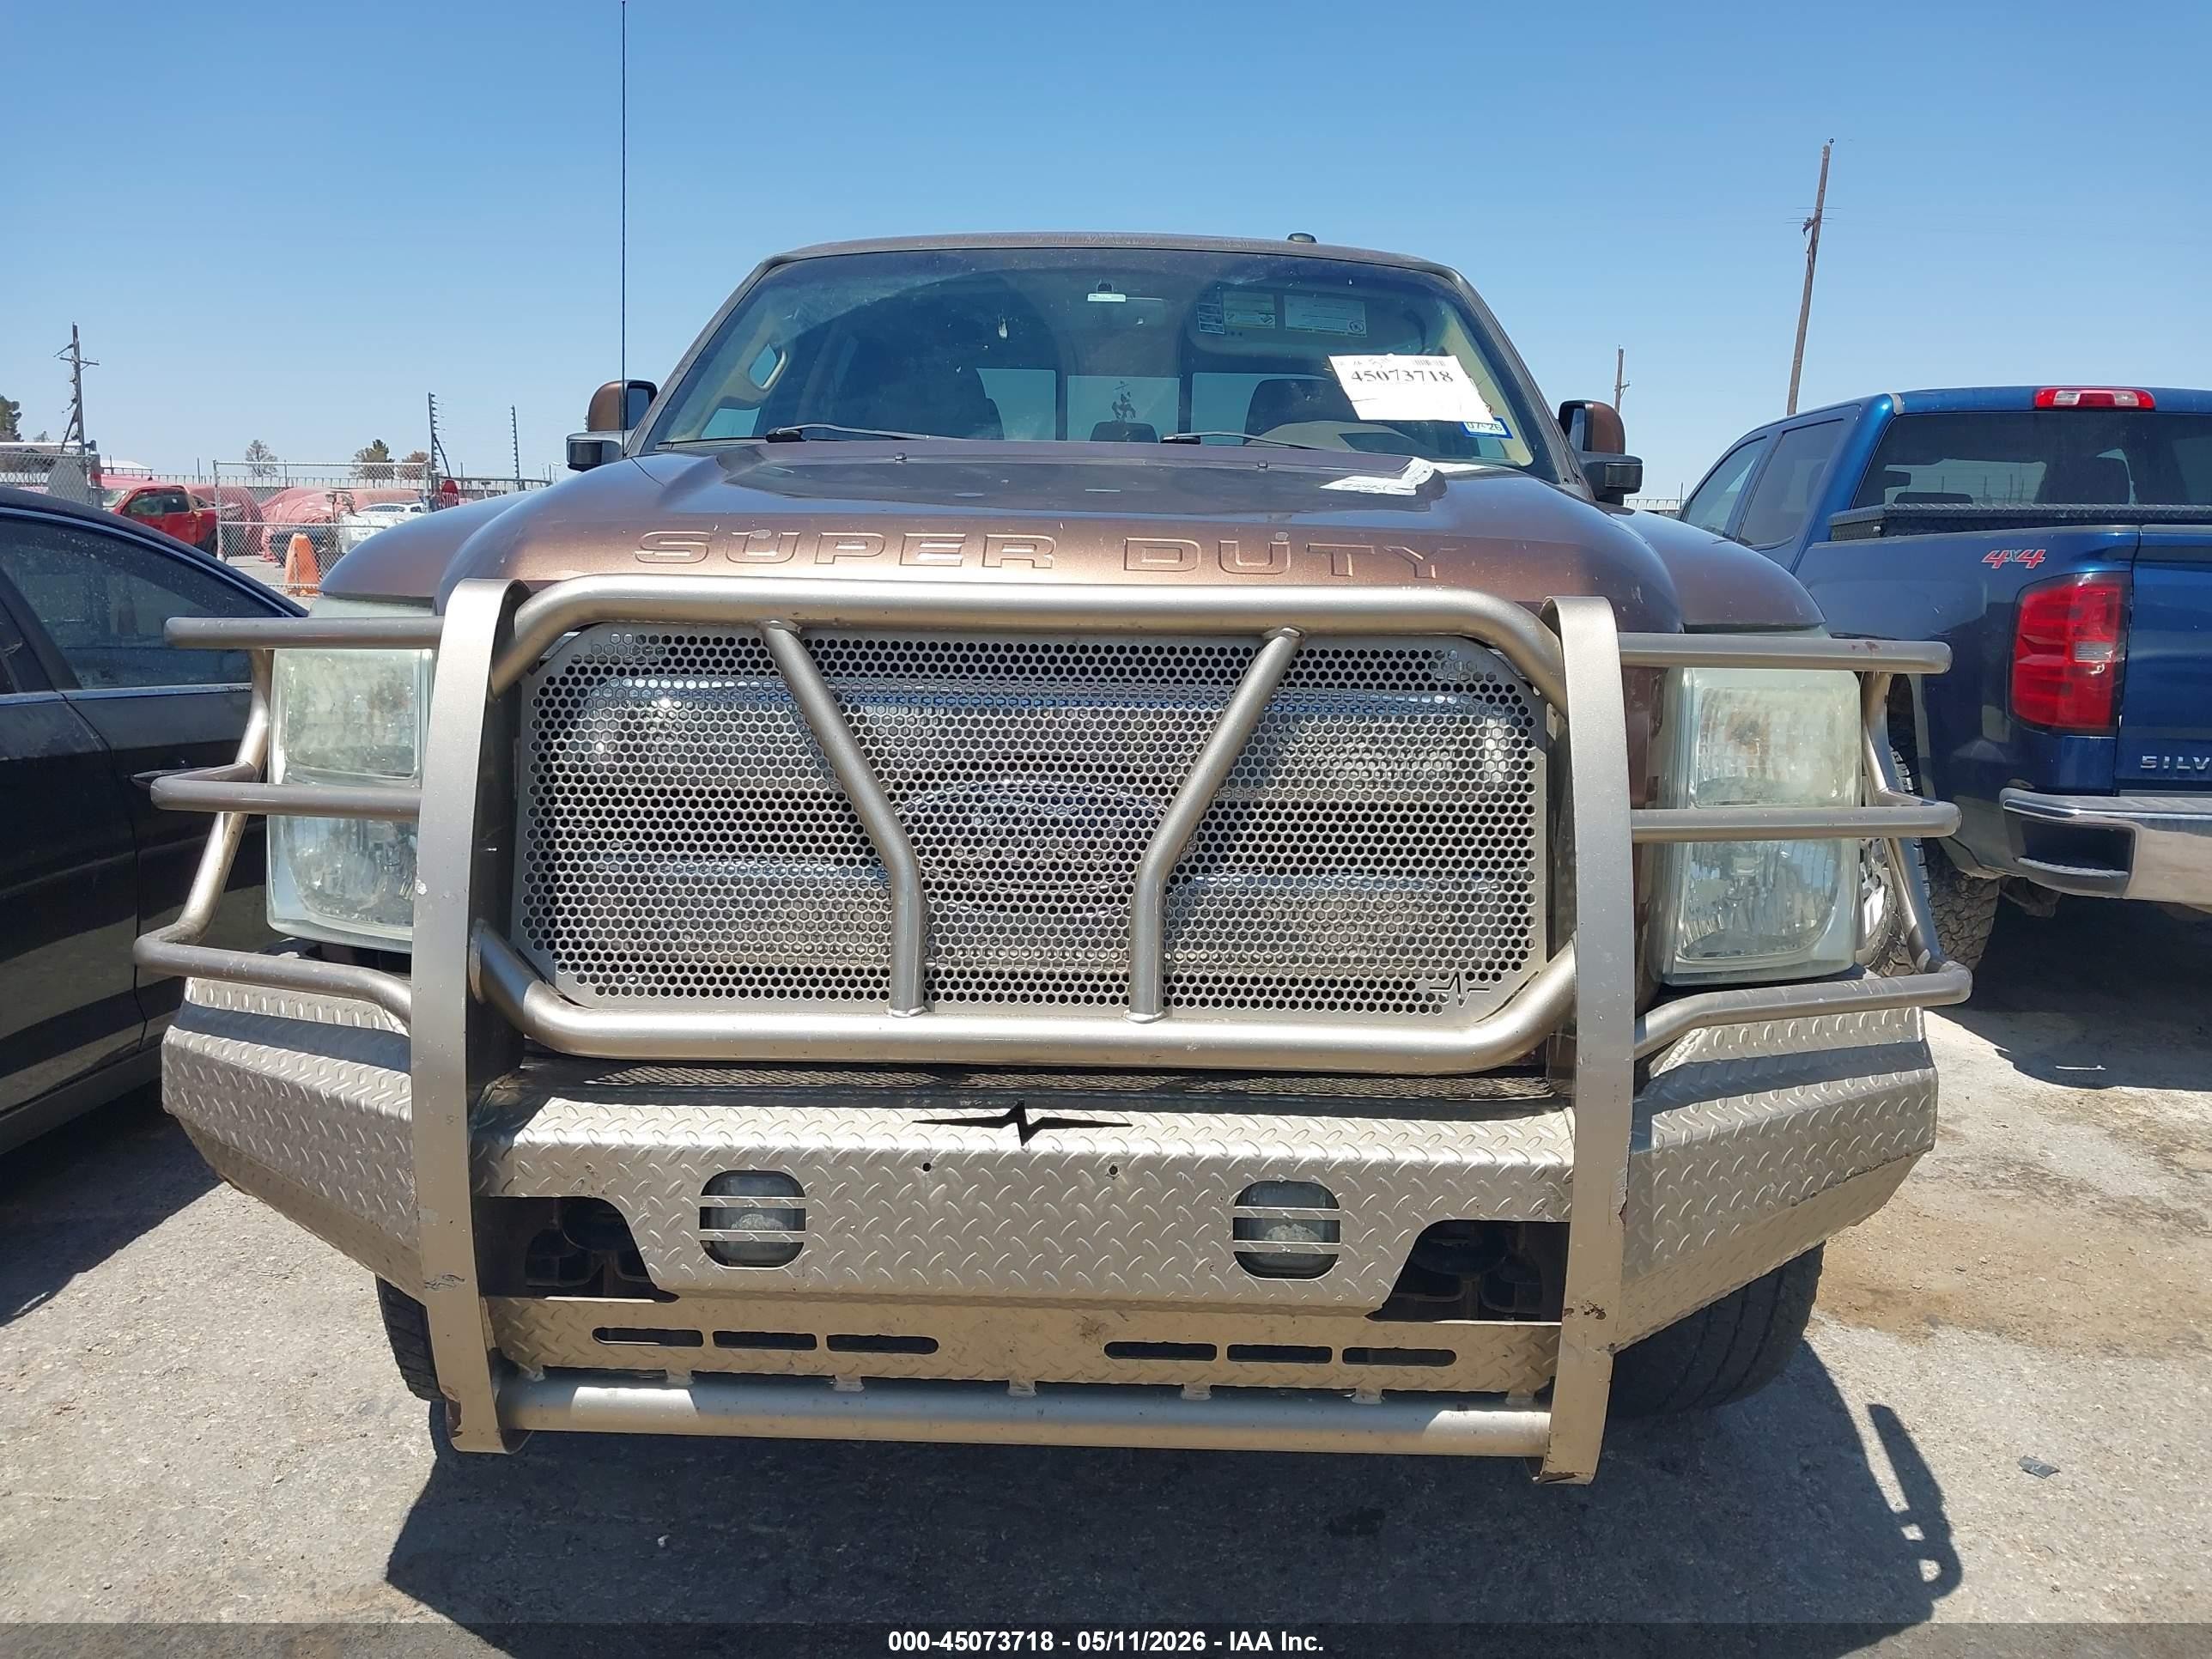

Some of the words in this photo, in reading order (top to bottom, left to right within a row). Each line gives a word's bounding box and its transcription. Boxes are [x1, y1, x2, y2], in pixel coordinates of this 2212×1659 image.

[1351, 368, 1455, 383] 45073718
[441, 492, 459, 508] STOP
[634, 530, 1058, 569] SUPER
[1123, 537, 1458, 579] DUTY
[2140, 755, 2211, 770] SILV
